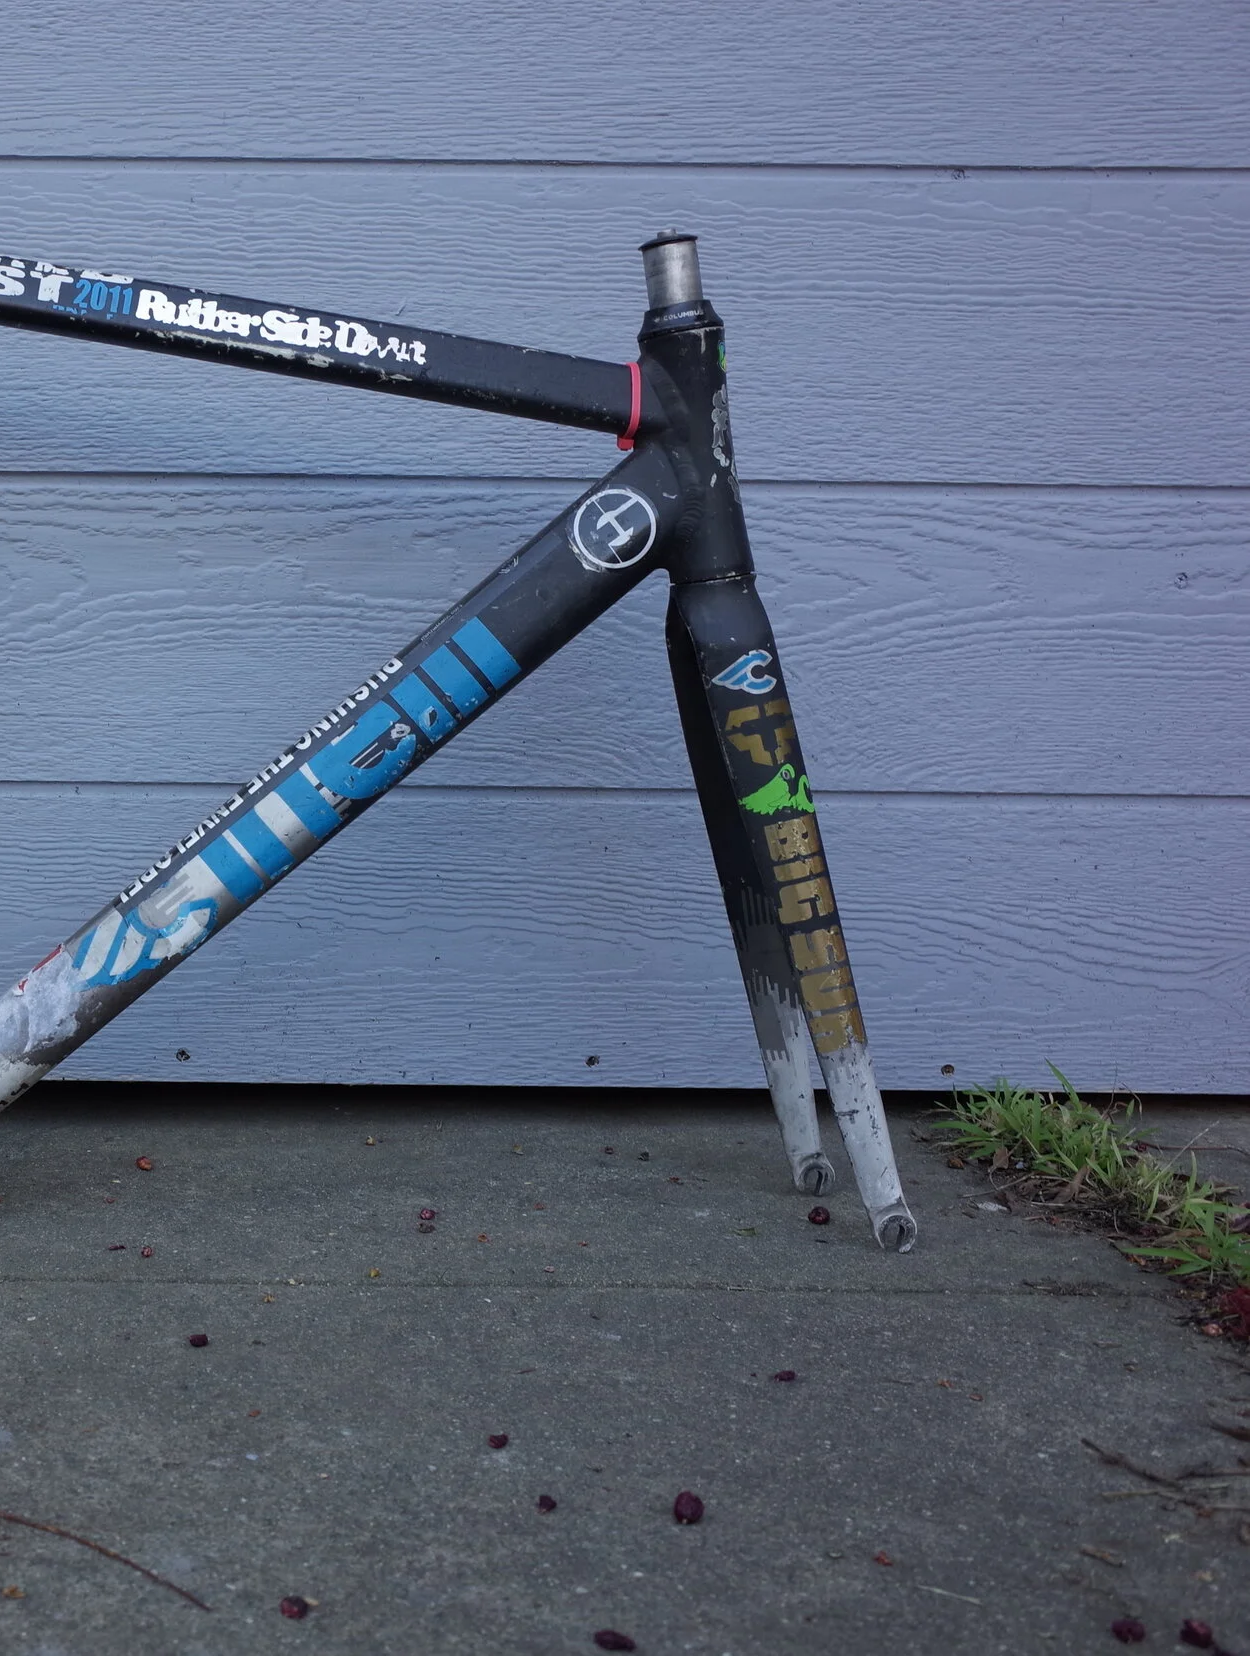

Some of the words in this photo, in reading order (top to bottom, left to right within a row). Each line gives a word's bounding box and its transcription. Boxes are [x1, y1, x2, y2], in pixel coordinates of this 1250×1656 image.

[72, 278, 133, 316] 2011
[135, 288, 261, 338] Rubber
[260, 308, 332, 349] Side
[662, 309, 705, 322] COLUMBUS
[295, 657, 404, 750] PUSHING
[247, 751, 295, 795] THE
[763, 813, 838, 925] BIG
